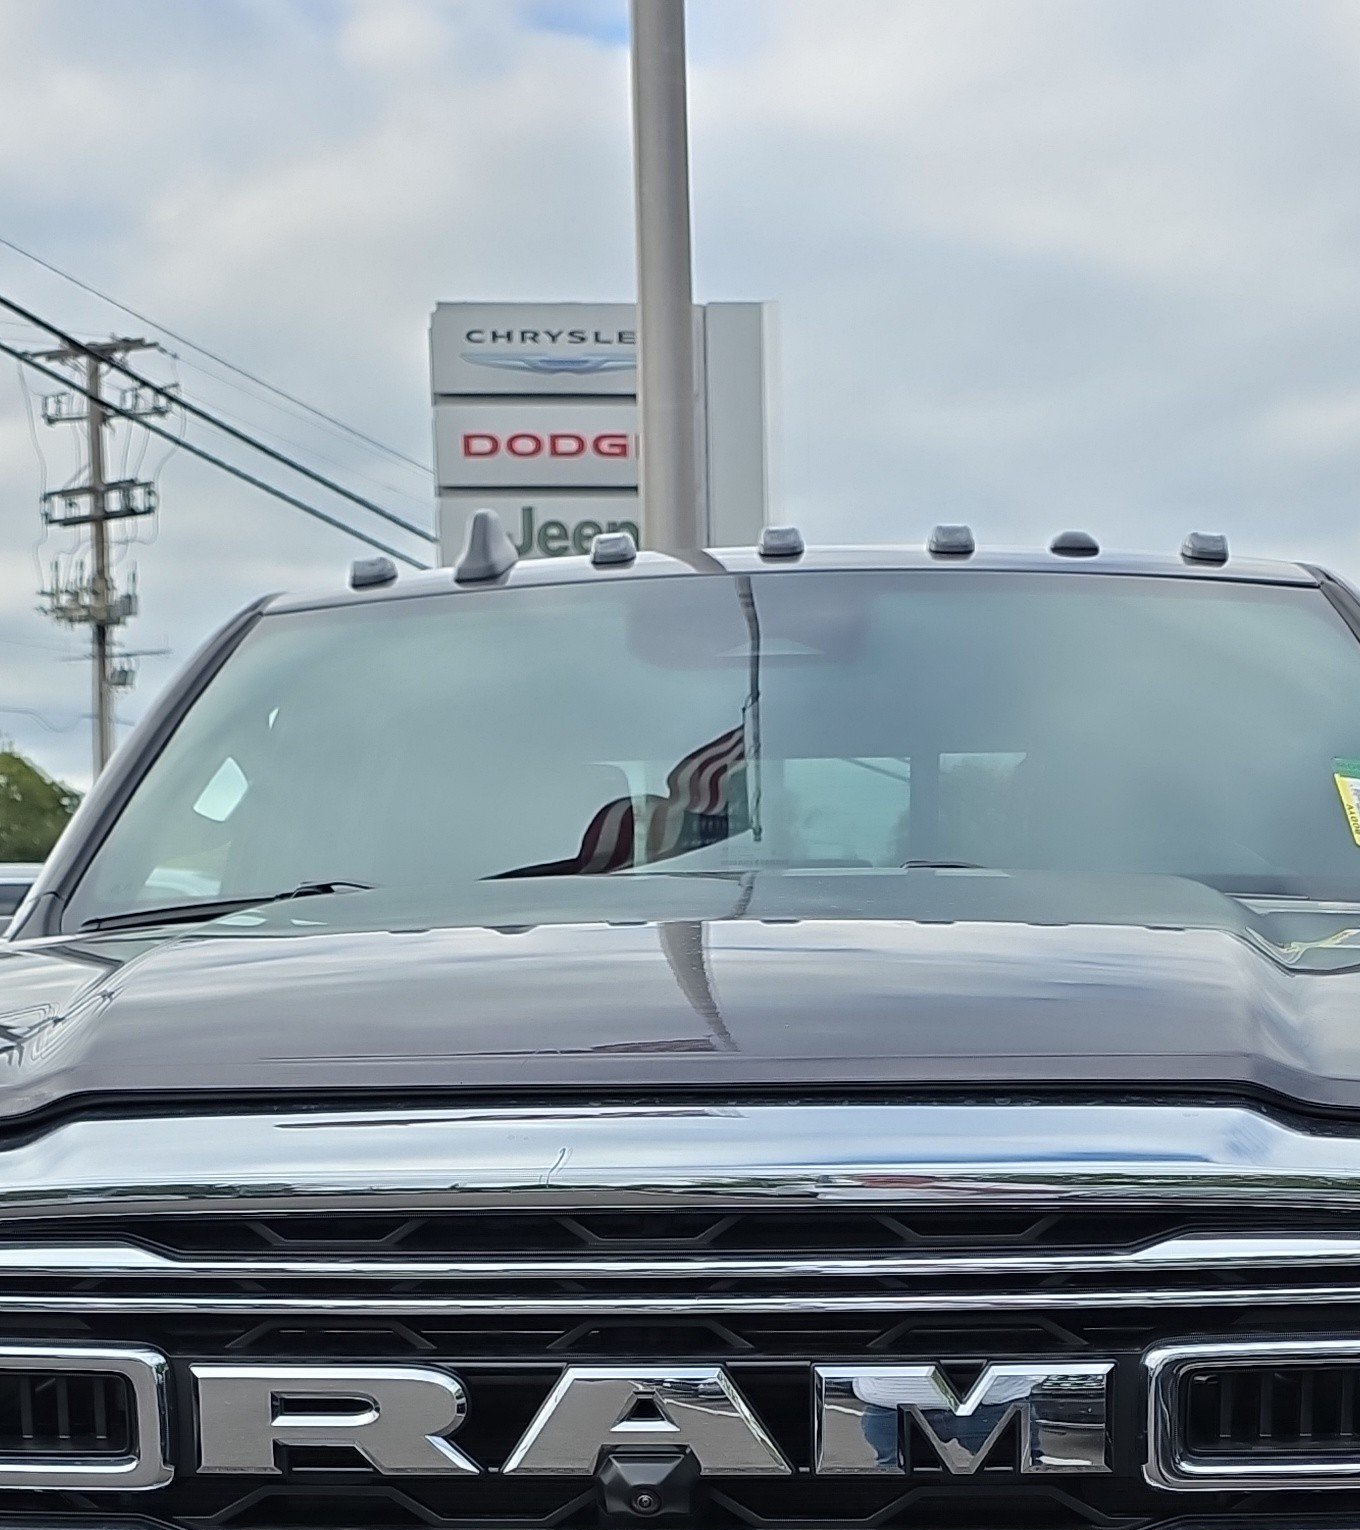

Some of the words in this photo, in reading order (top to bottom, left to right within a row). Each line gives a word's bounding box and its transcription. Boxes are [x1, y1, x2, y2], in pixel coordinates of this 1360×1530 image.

[465, 329, 636, 344] CHRYSLE
[463, 433, 637, 458] DODG
[189, 1361, 1115, 1474] RAM
